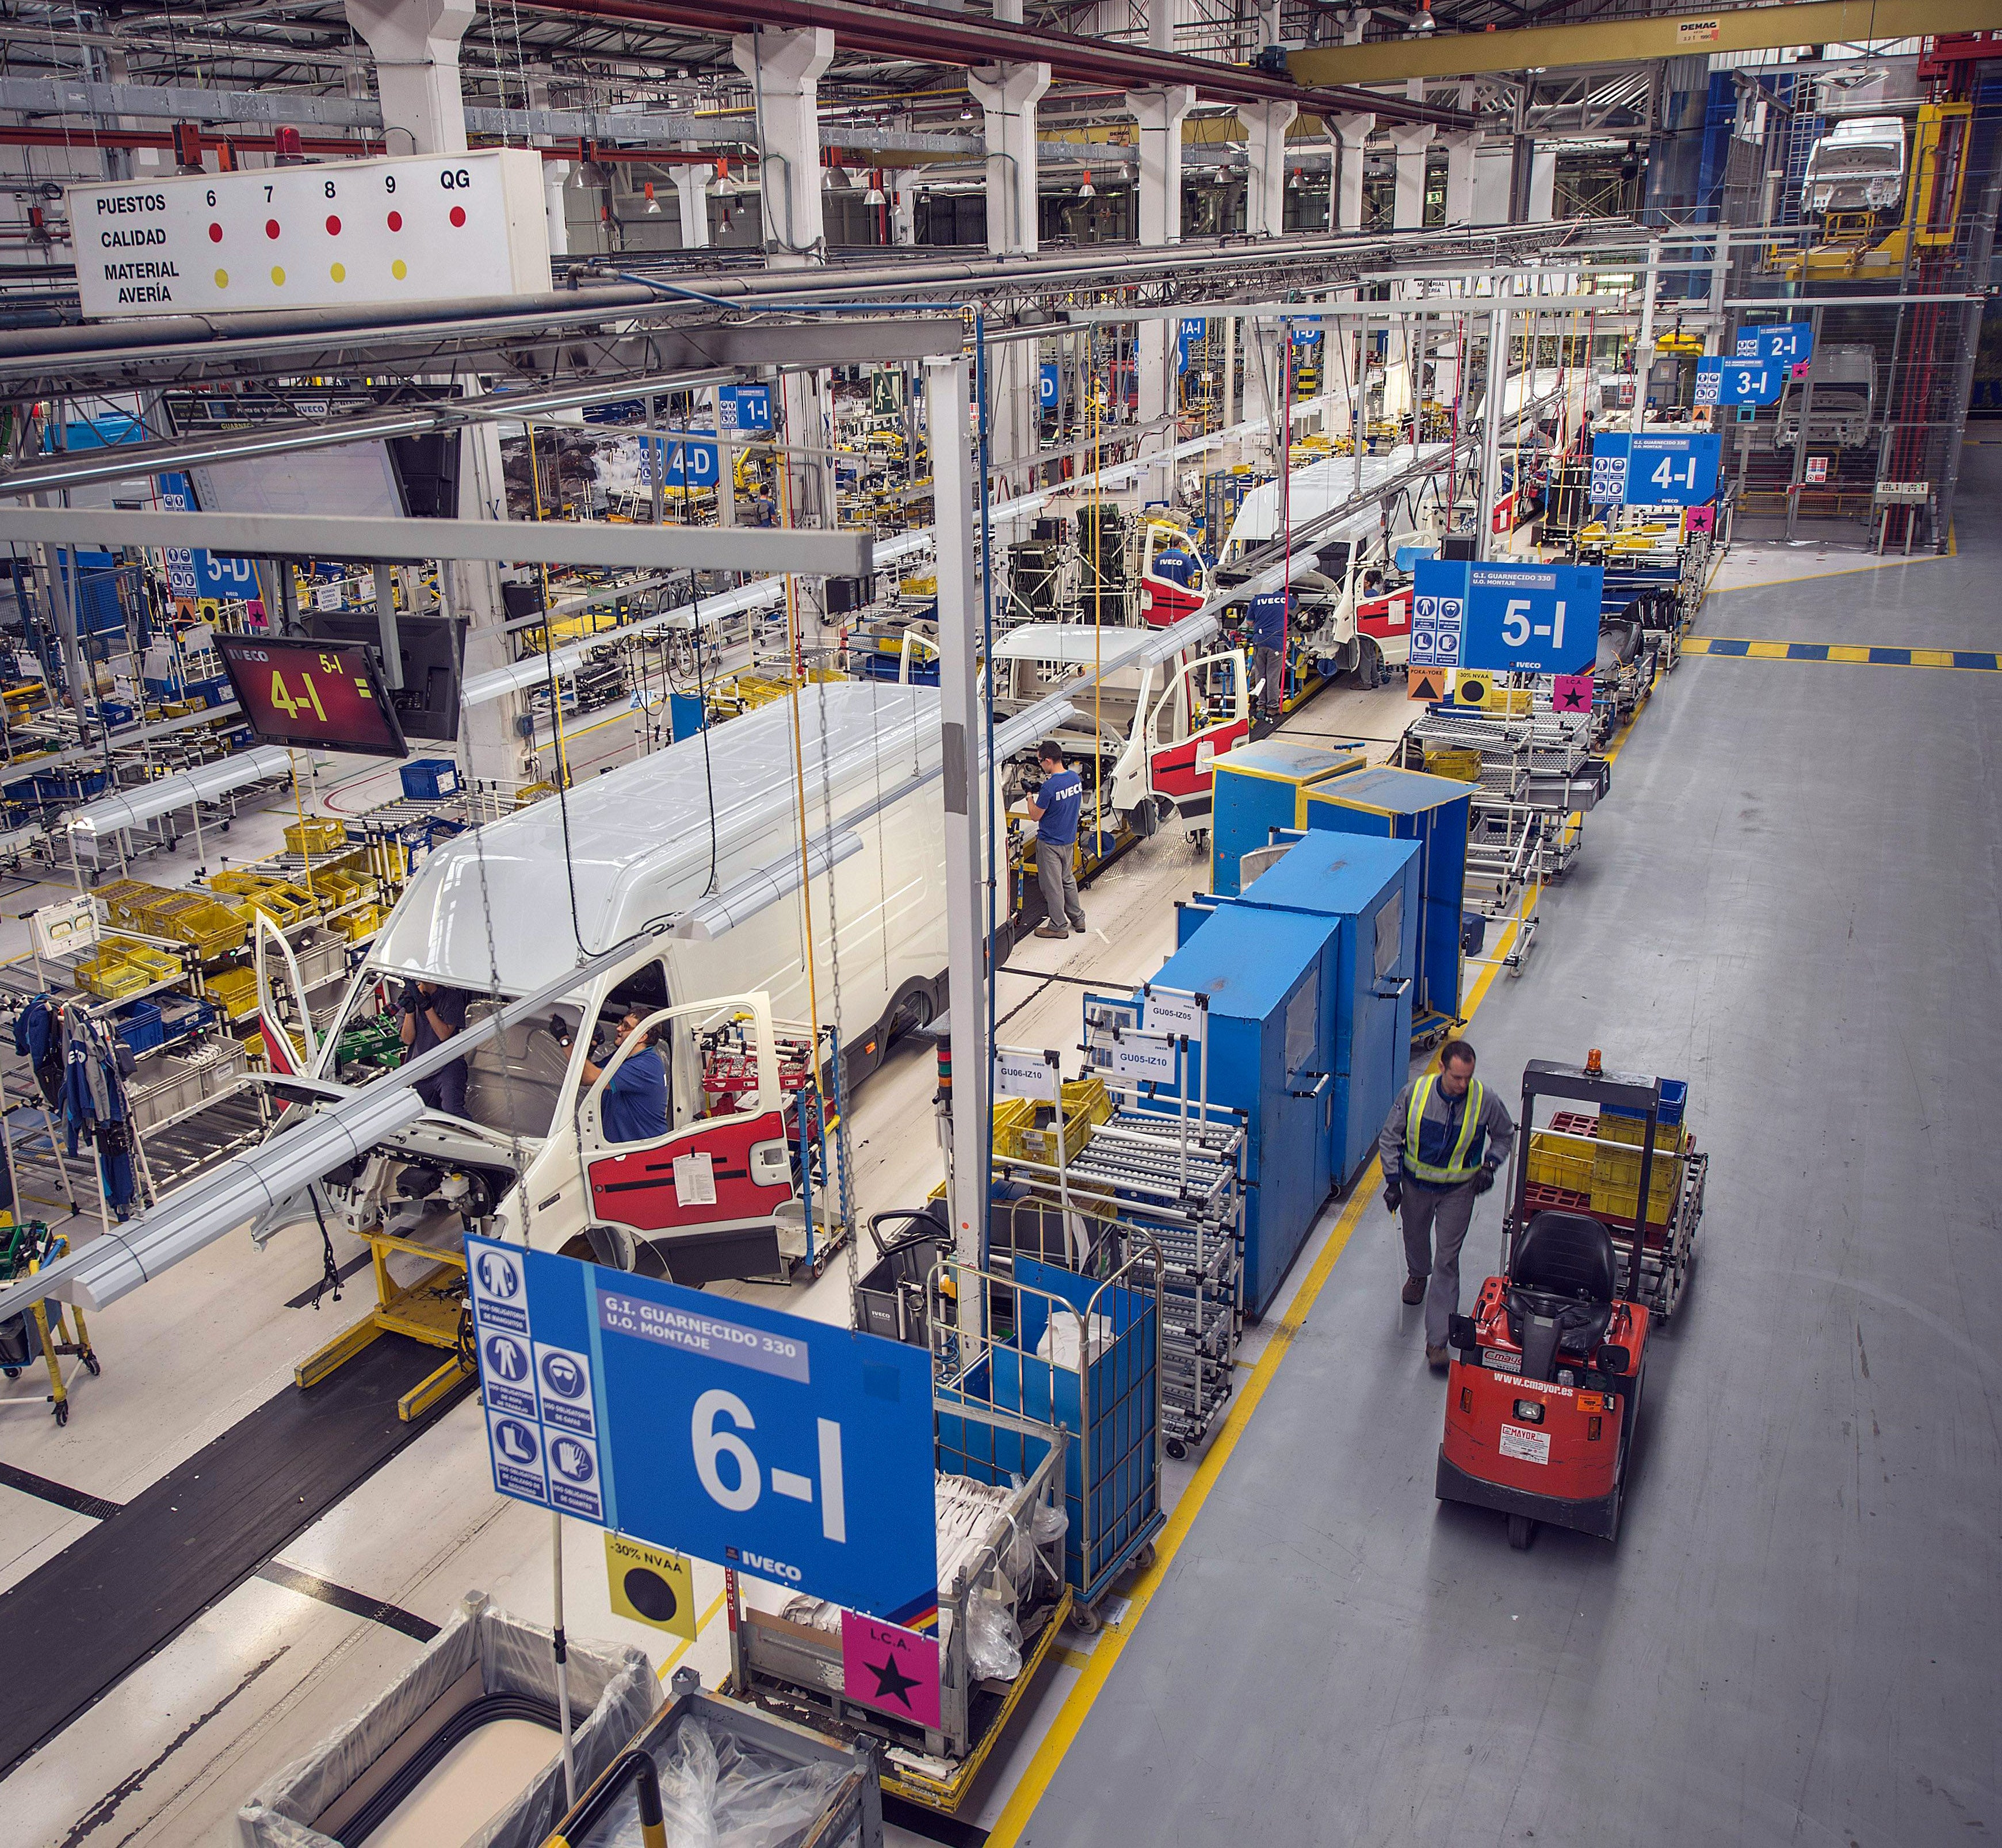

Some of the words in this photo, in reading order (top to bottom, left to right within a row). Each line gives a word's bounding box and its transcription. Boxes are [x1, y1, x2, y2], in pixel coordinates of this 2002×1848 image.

[1680, 22, 1717, 31] DEMAG
[206, 189, 216, 207] 6
[263, 185, 273, 203] 7
[325, 181, 336, 199] 8
[385, 175, 396, 193] 9
[440, 169, 471, 190] QG
[97, 194, 166, 215] PUESTOS
[101, 228, 166, 248] CALIDAD
[104, 261, 179, 281] MATERIAL
[118, 281, 173, 304] AVERÍA
[1771, 336, 1796, 356] 2-I
[1736, 372, 1767, 394] 3-I
[297, 405, 324, 414] IVECO
[747, 400, 767, 420] 1-I
[673, 449, 710, 474] 4-D
[1651, 457, 1696, 489] 4-I
[207, 548, 250, 581] 5-D
[1257, 597, 1286, 605] IVECO
[1501, 599, 1566, 648] 5-I
[229, 649, 269, 662] IVECO
[319, 654, 343, 674] 5-I
[271, 671, 327, 722] 4-I
[1153, 1007, 1192, 1021] GU05-IZ05
[1120, 1053, 1167, 1068] GU05-IZ10
[1001, 1068, 1042, 1080] GU06-IZ10
[872, 1310, 891, 1318] IVECO
[605, 1297, 636, 1317] G.I.
[640, 1306, 757, 1348] GUARNECIDO
[762, 1337, 796, 1359] 330
[606, 1313, 636, 1331] U.O.
[641, 1322, 710, 1350] MONTAJE
[1493, 1372, 1573, 1397] www.cmayor.es
[691, 1389, 846, 1544] 6-I
[610, 1543, 641, 1560] -30%
[644, 1552, 682, 1574] NVAA
[742, 1550, 802, 1582] IVECO
[870, 1627, 911, 1652] L.C.A.
